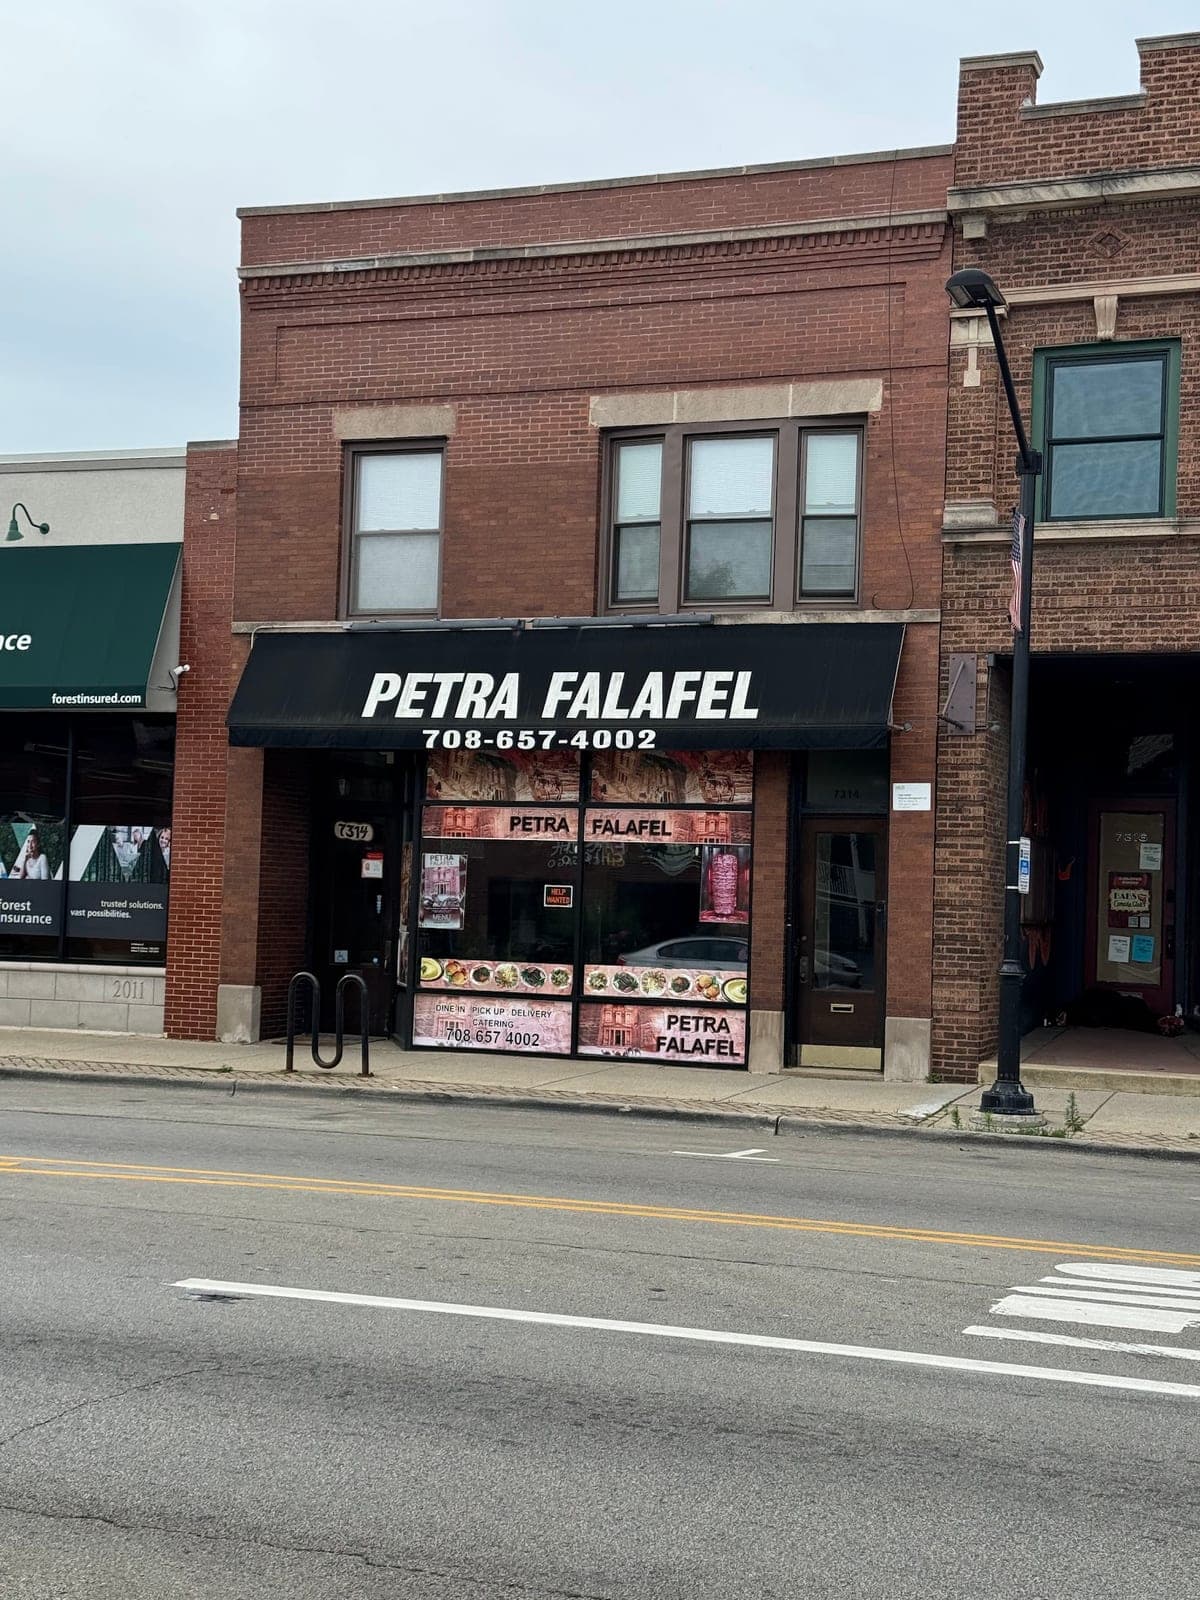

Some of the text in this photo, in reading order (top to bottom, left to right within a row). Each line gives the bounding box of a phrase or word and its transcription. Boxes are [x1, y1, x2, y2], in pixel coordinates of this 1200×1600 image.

[51, 692, 142, 705] forestinsured.com
[361, 670, 760, 720] PETRA FALAFEL
[422, 729, 657, 750] 708-657-4002
[338, 823, 369, 839] 7314
[510, 816, 672, 837] PETRA FALAFEL
[101, 900, 164, 910] trusted solutions.
[546, 896, 570, 905] WANTED
[70, 909, 132, 919] vast possibilities.
[112, 980, 145, 1000] 2011
[435, 1004, 455, 1013] DINE
[457, 1005, 466, 1013] IN
[472, 1006, 491, 1015] PICK
[511, 1009, 552, 1018] DELIVERY
[472, 1018, 514, 1029] CATERING
[667, 1014, 731, 1034] PETRA
[446, 1027, 540, 1047] 708 657 4002
[655, 1036, 741, 1057] FALAFEL
